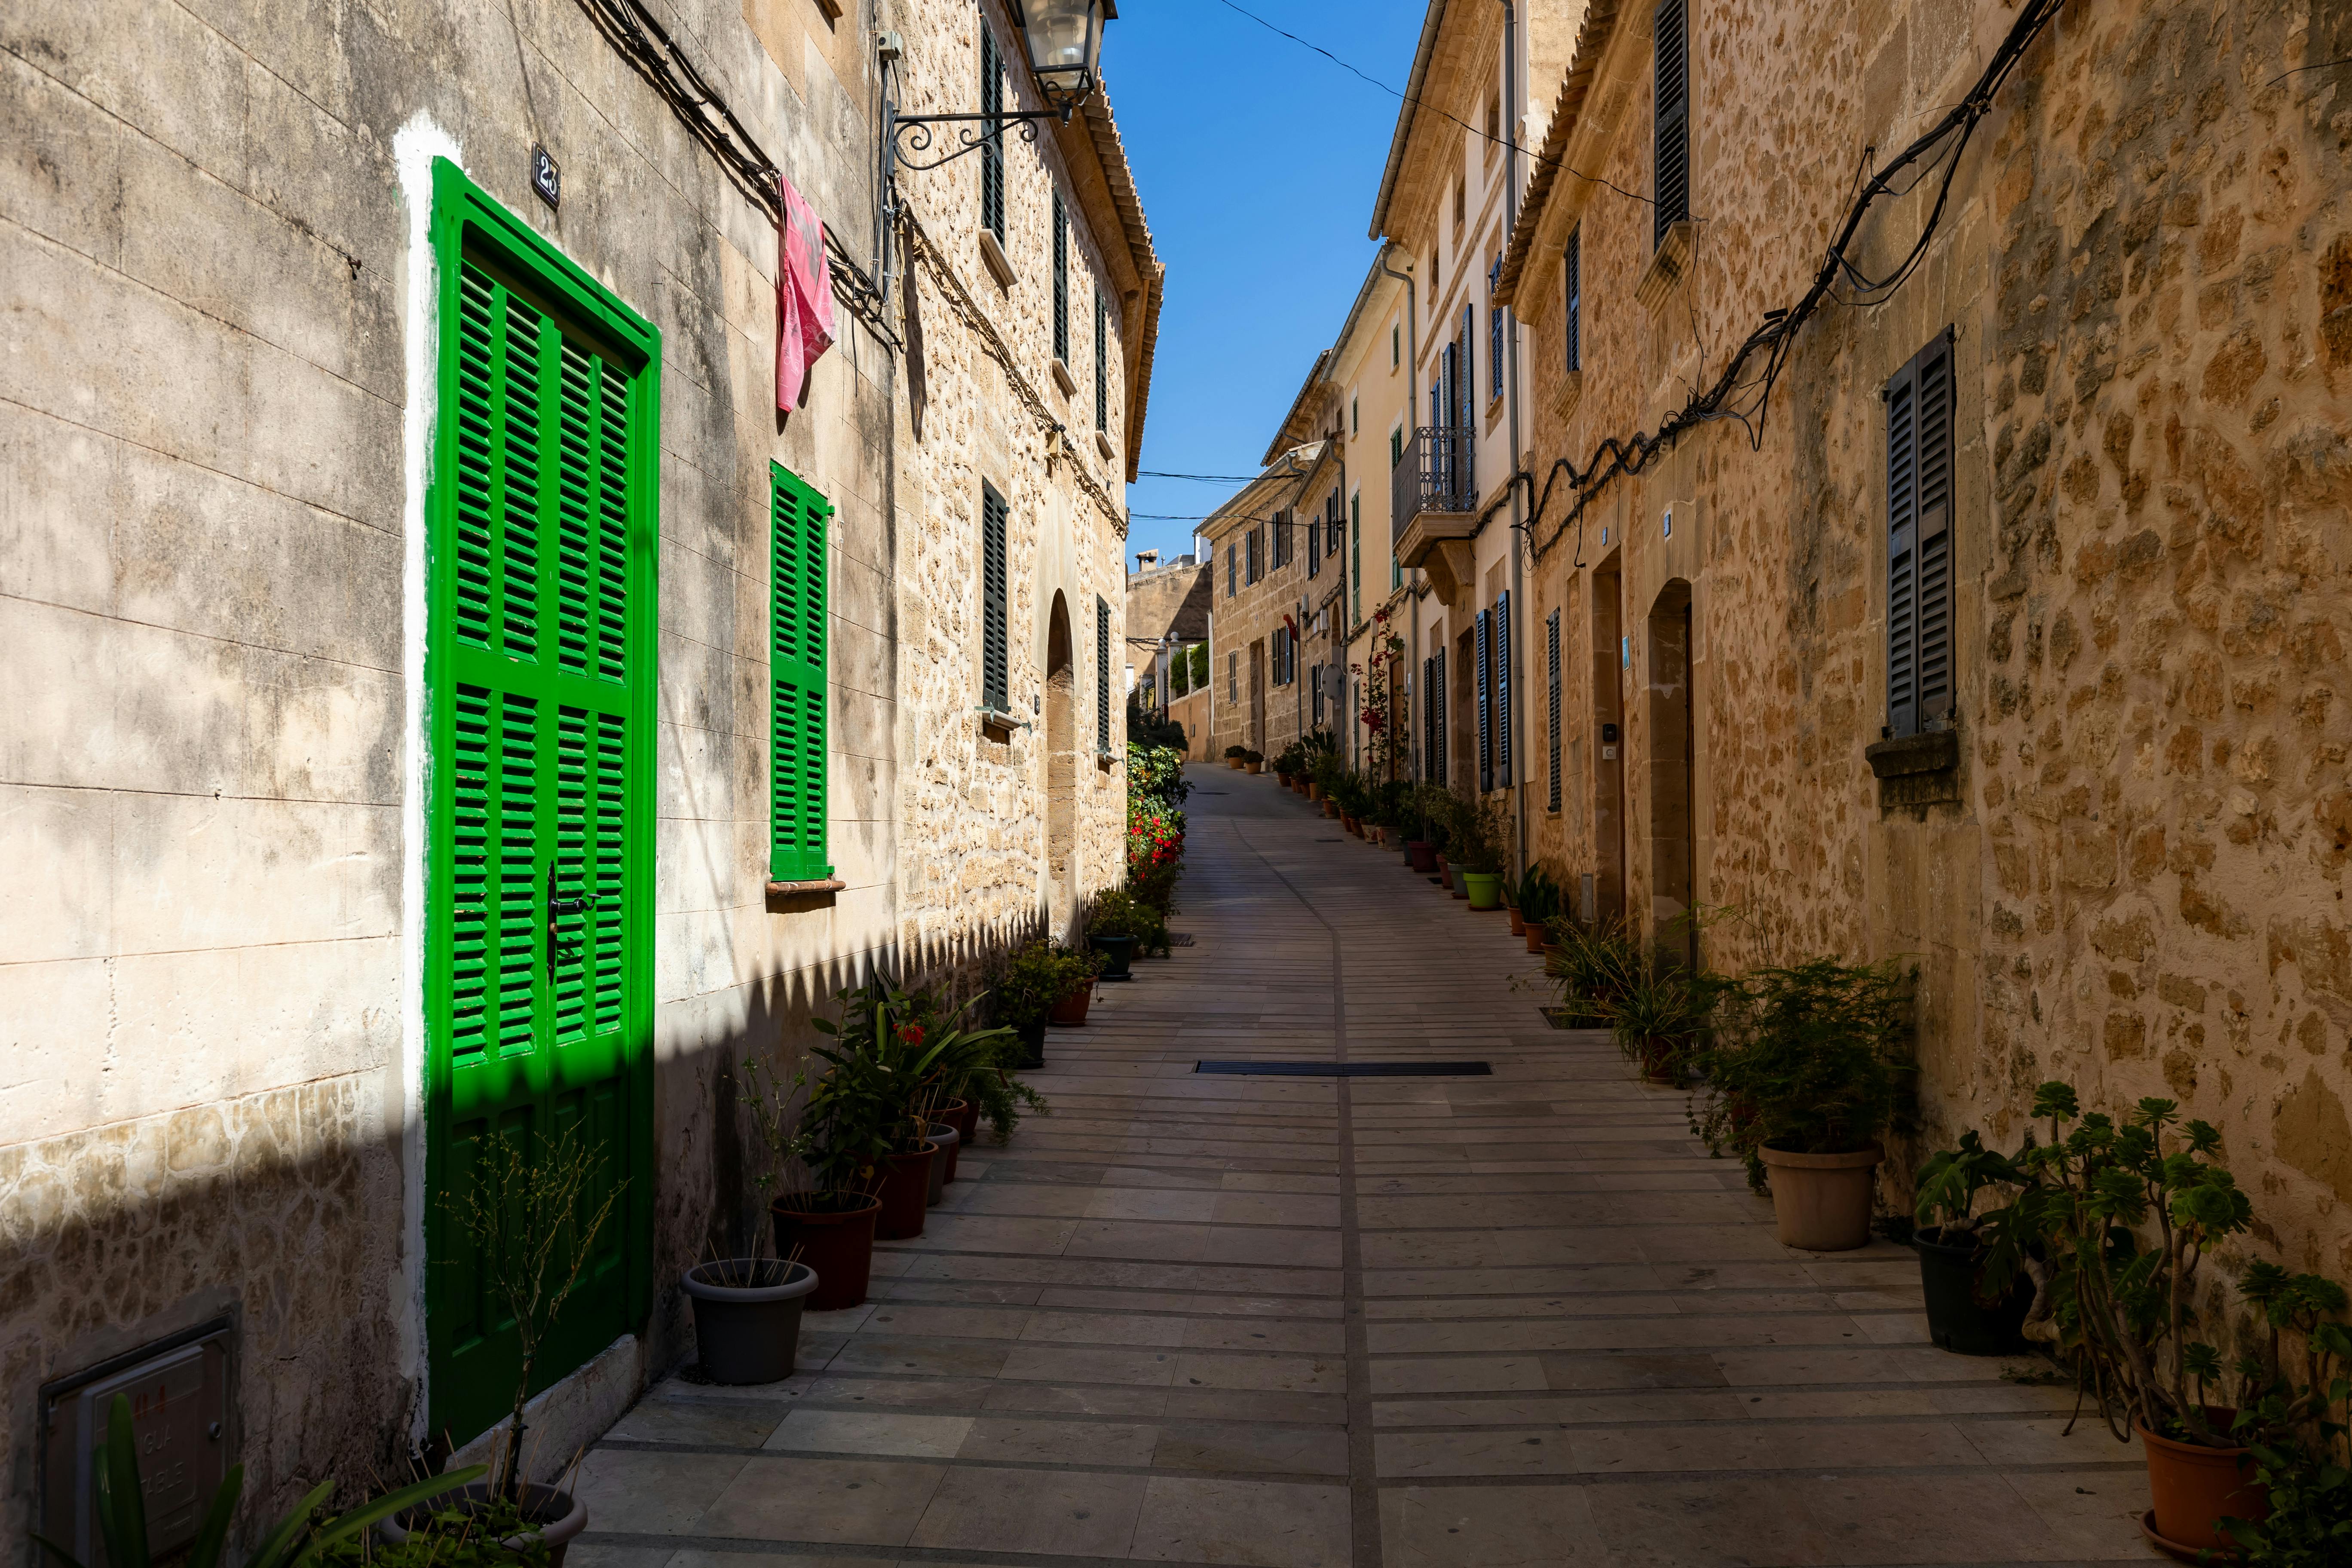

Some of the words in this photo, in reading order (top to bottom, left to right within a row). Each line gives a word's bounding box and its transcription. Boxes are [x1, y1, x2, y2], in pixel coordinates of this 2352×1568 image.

[540, 156, 557, 195] 23
[135, 1424, 172, 1456] IGUA
[141, 1462, 184, 1500] TABLE
